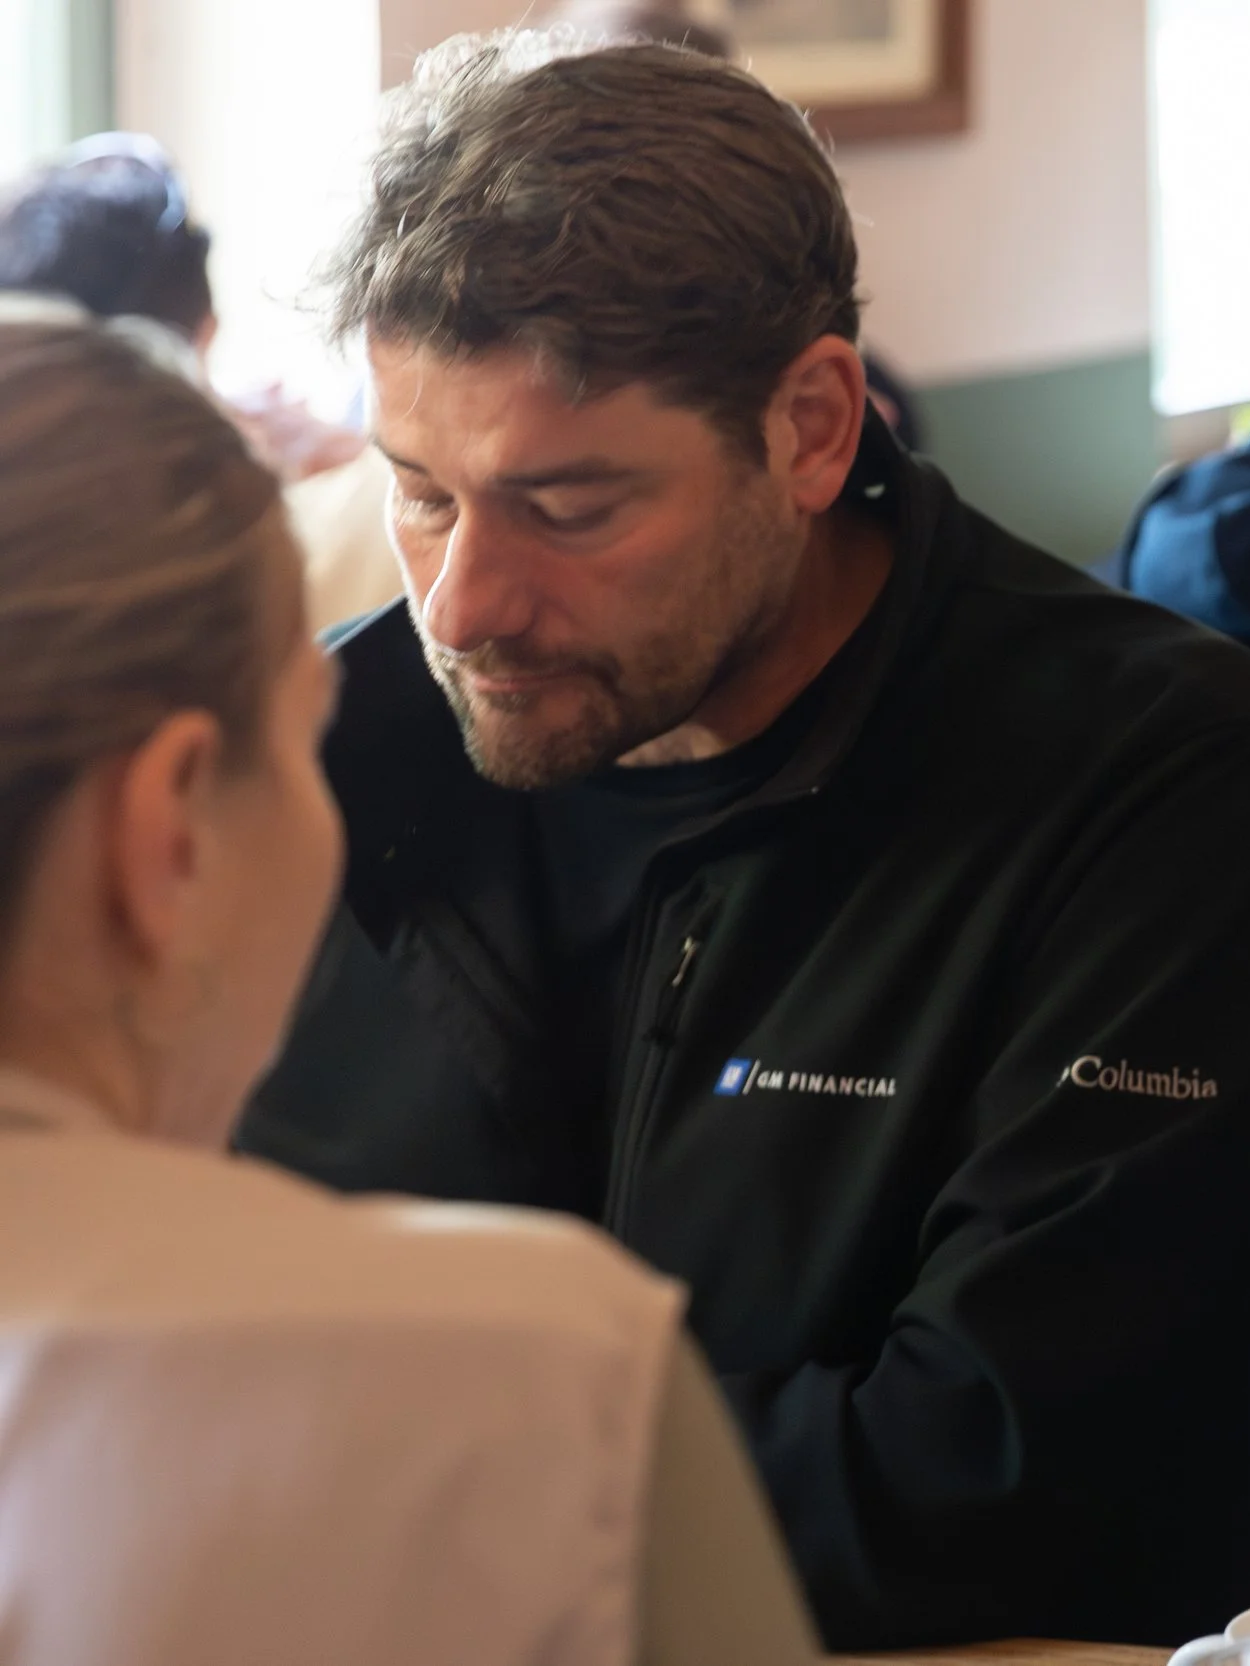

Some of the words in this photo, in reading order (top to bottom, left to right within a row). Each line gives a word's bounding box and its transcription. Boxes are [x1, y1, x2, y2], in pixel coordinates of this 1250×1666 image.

[756, 1070, 784, 1090] GM
[788, 1071, 896, 1097] FINANCIAL
[1071, 1055, 1217, 1099] Columbia
